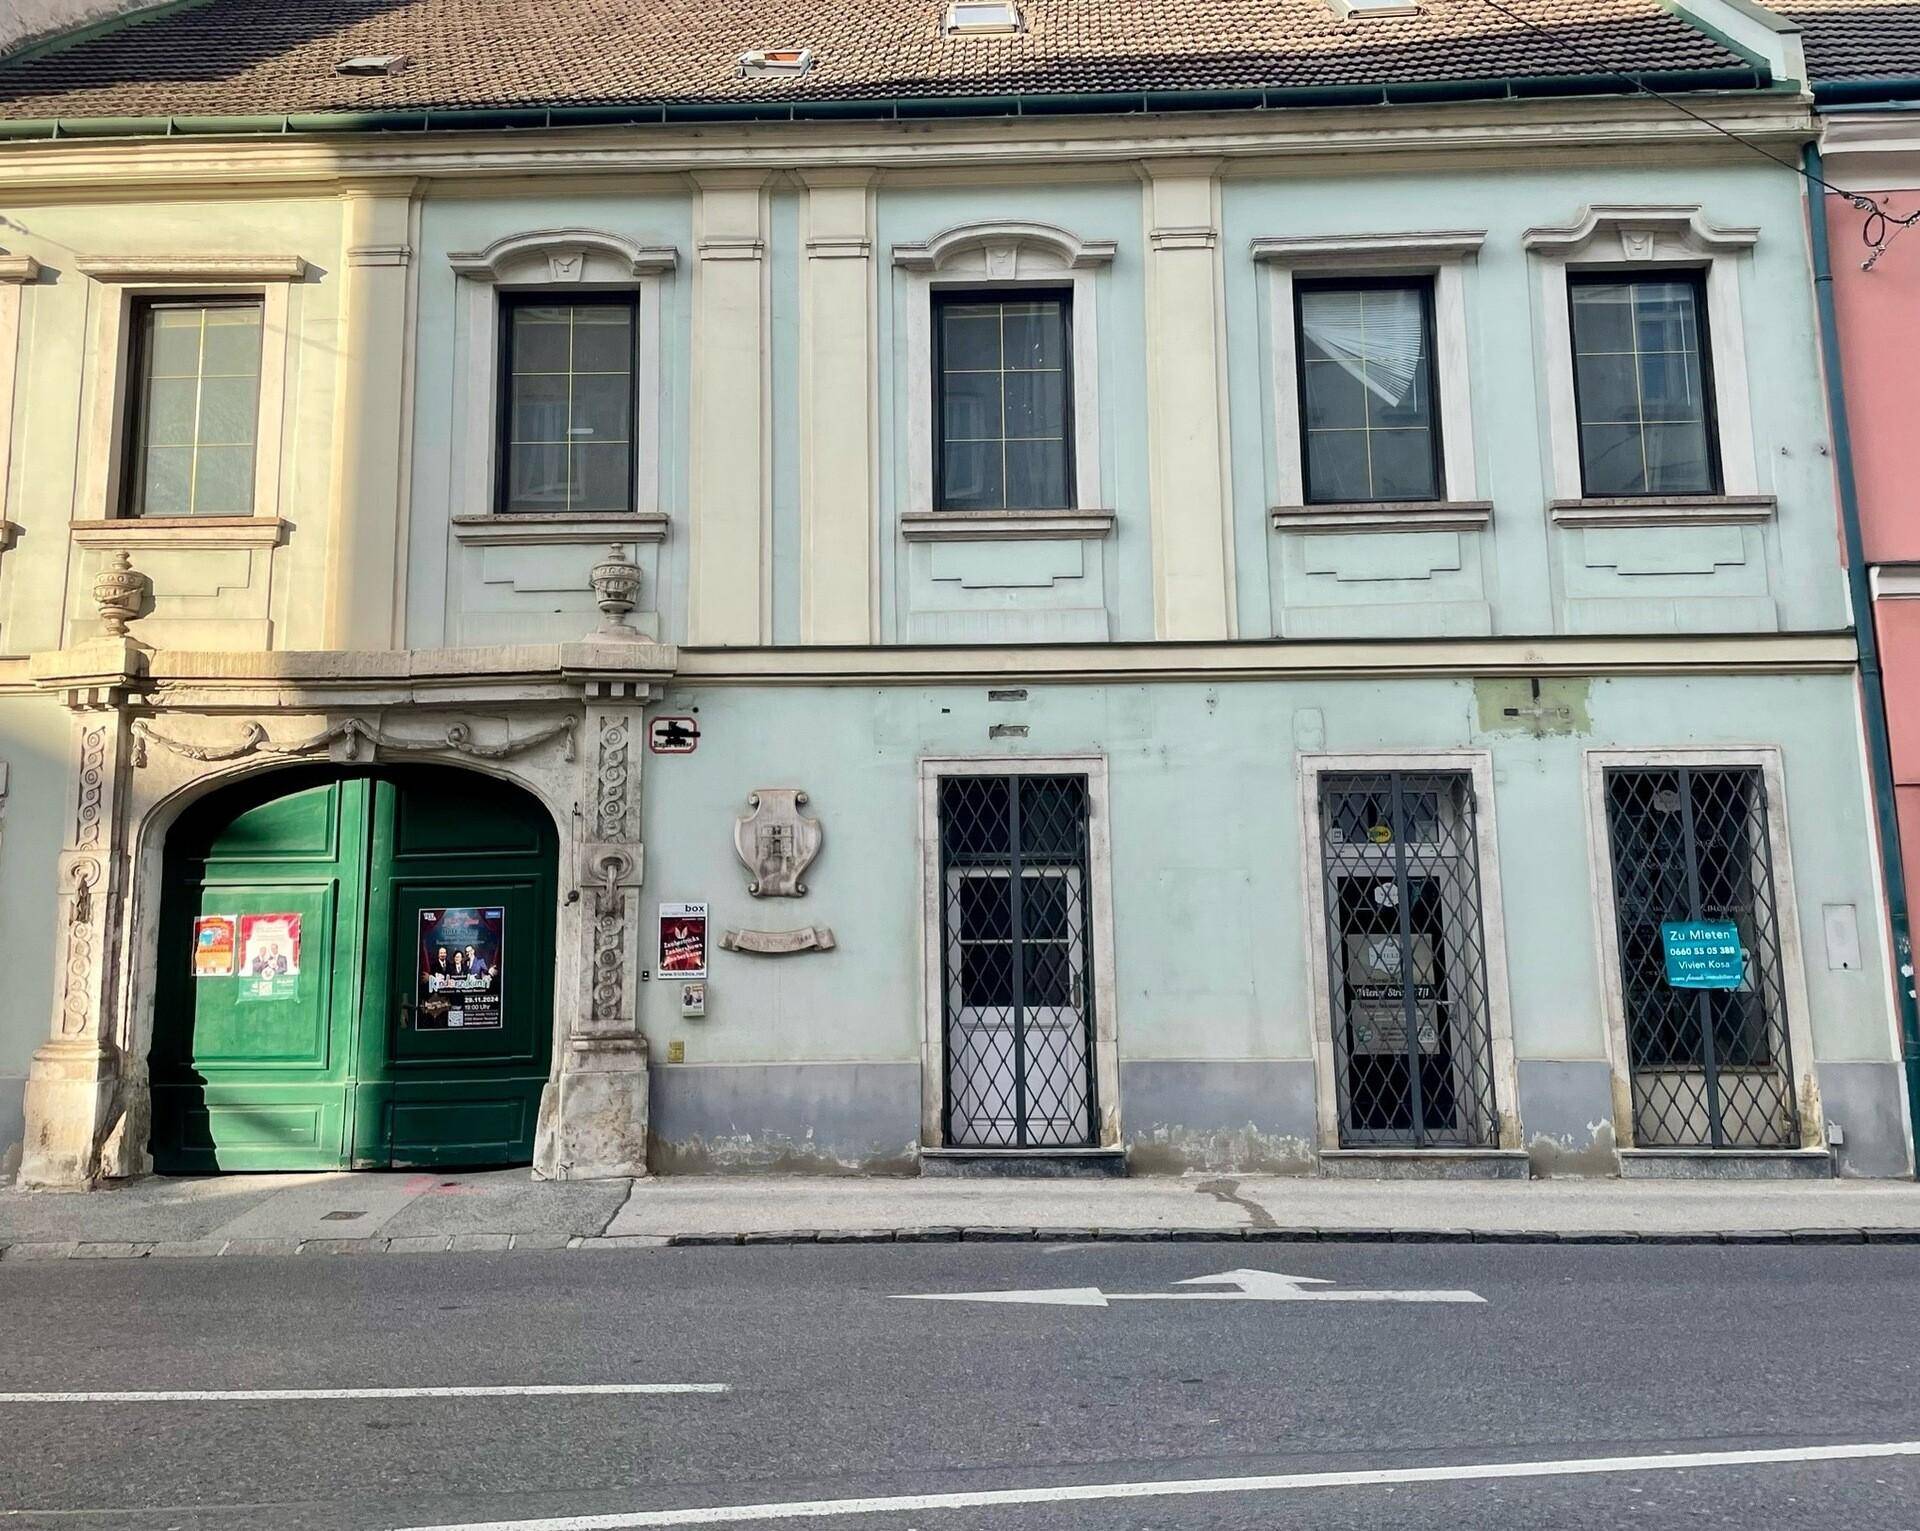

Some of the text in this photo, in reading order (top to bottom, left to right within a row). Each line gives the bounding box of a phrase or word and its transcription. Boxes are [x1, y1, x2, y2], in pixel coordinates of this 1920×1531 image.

[1670, 930, 1730, 941] Zu Mieten
[1670, 948, 1692, 956] 0660
[1706, 947, 1718, 955] 05
[1678, 960, 1730, 969] Vivien Kosa
